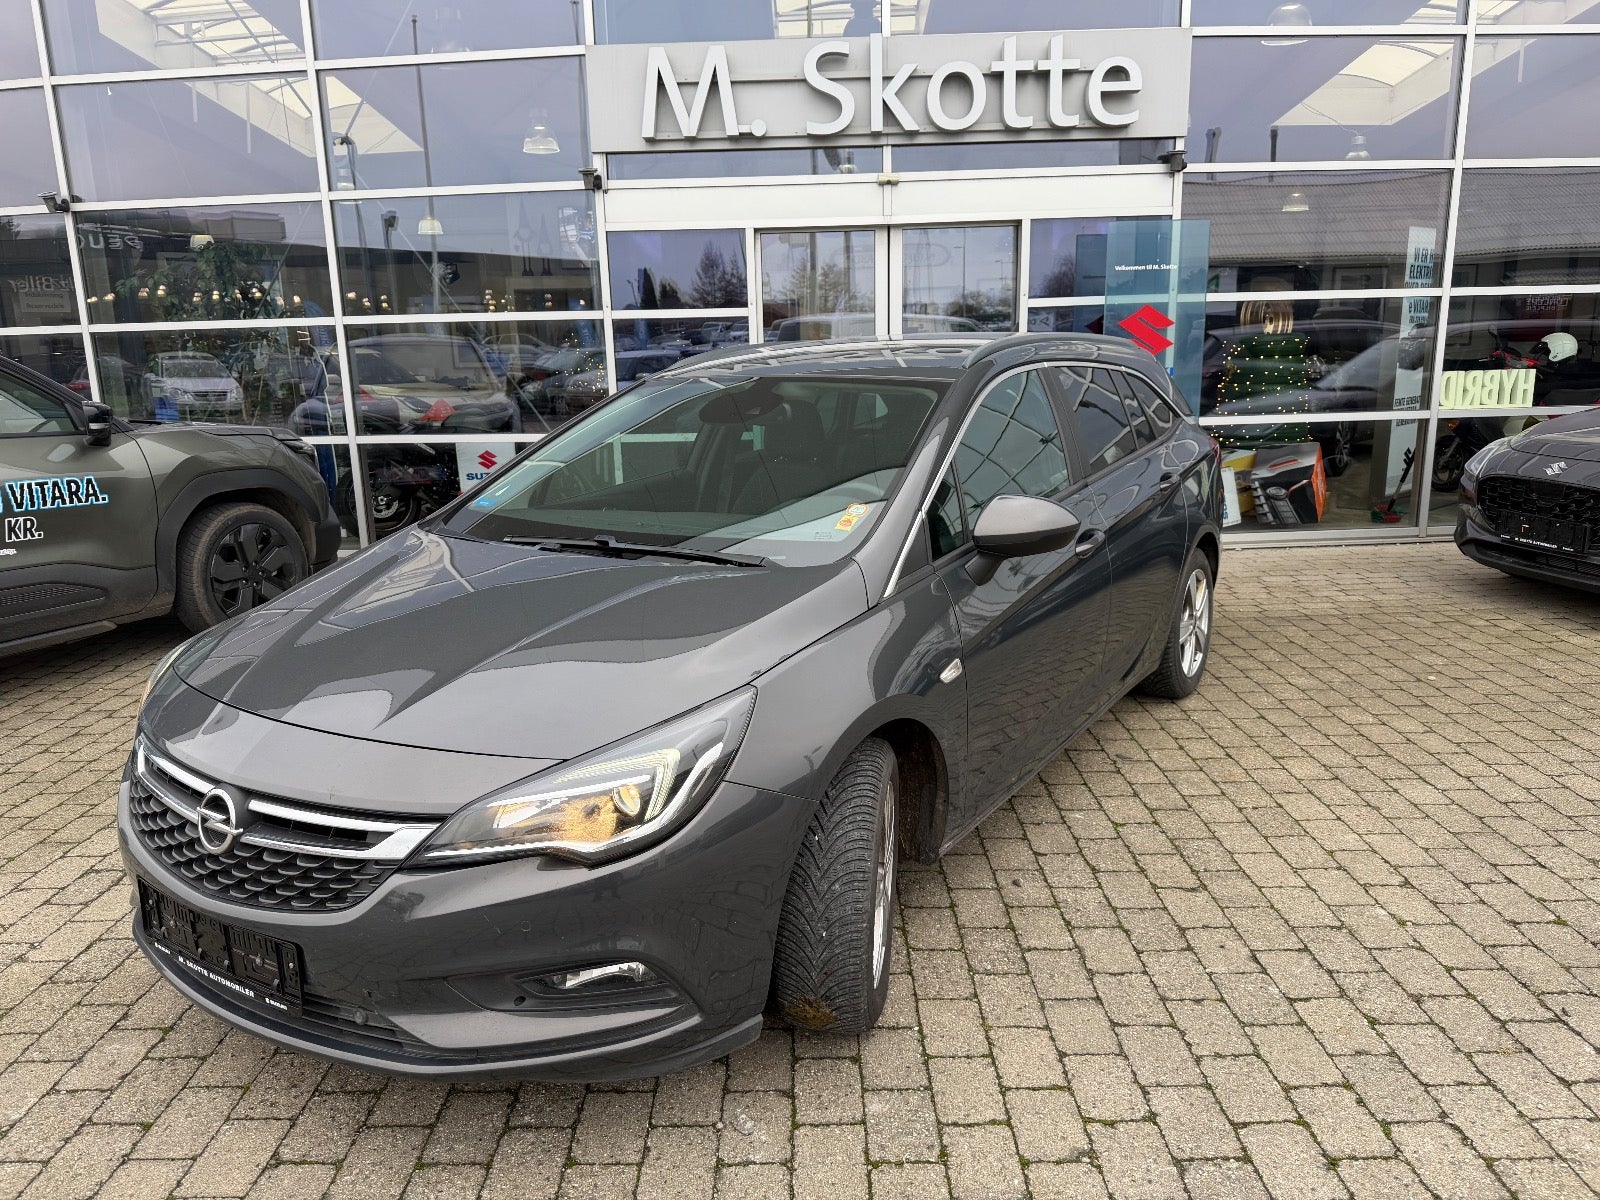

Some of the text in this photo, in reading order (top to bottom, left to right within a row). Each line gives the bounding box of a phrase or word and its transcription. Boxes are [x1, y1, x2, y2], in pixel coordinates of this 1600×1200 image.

[641, 33, 1143, 142] M. Skotte
[6, 476, 109, 512] VITARA.
[5, 516, 44, 543] KR.
[187, 961, 208, 977] SKOTTE
[209, 973, 255, 997] AUTOMOBILER
